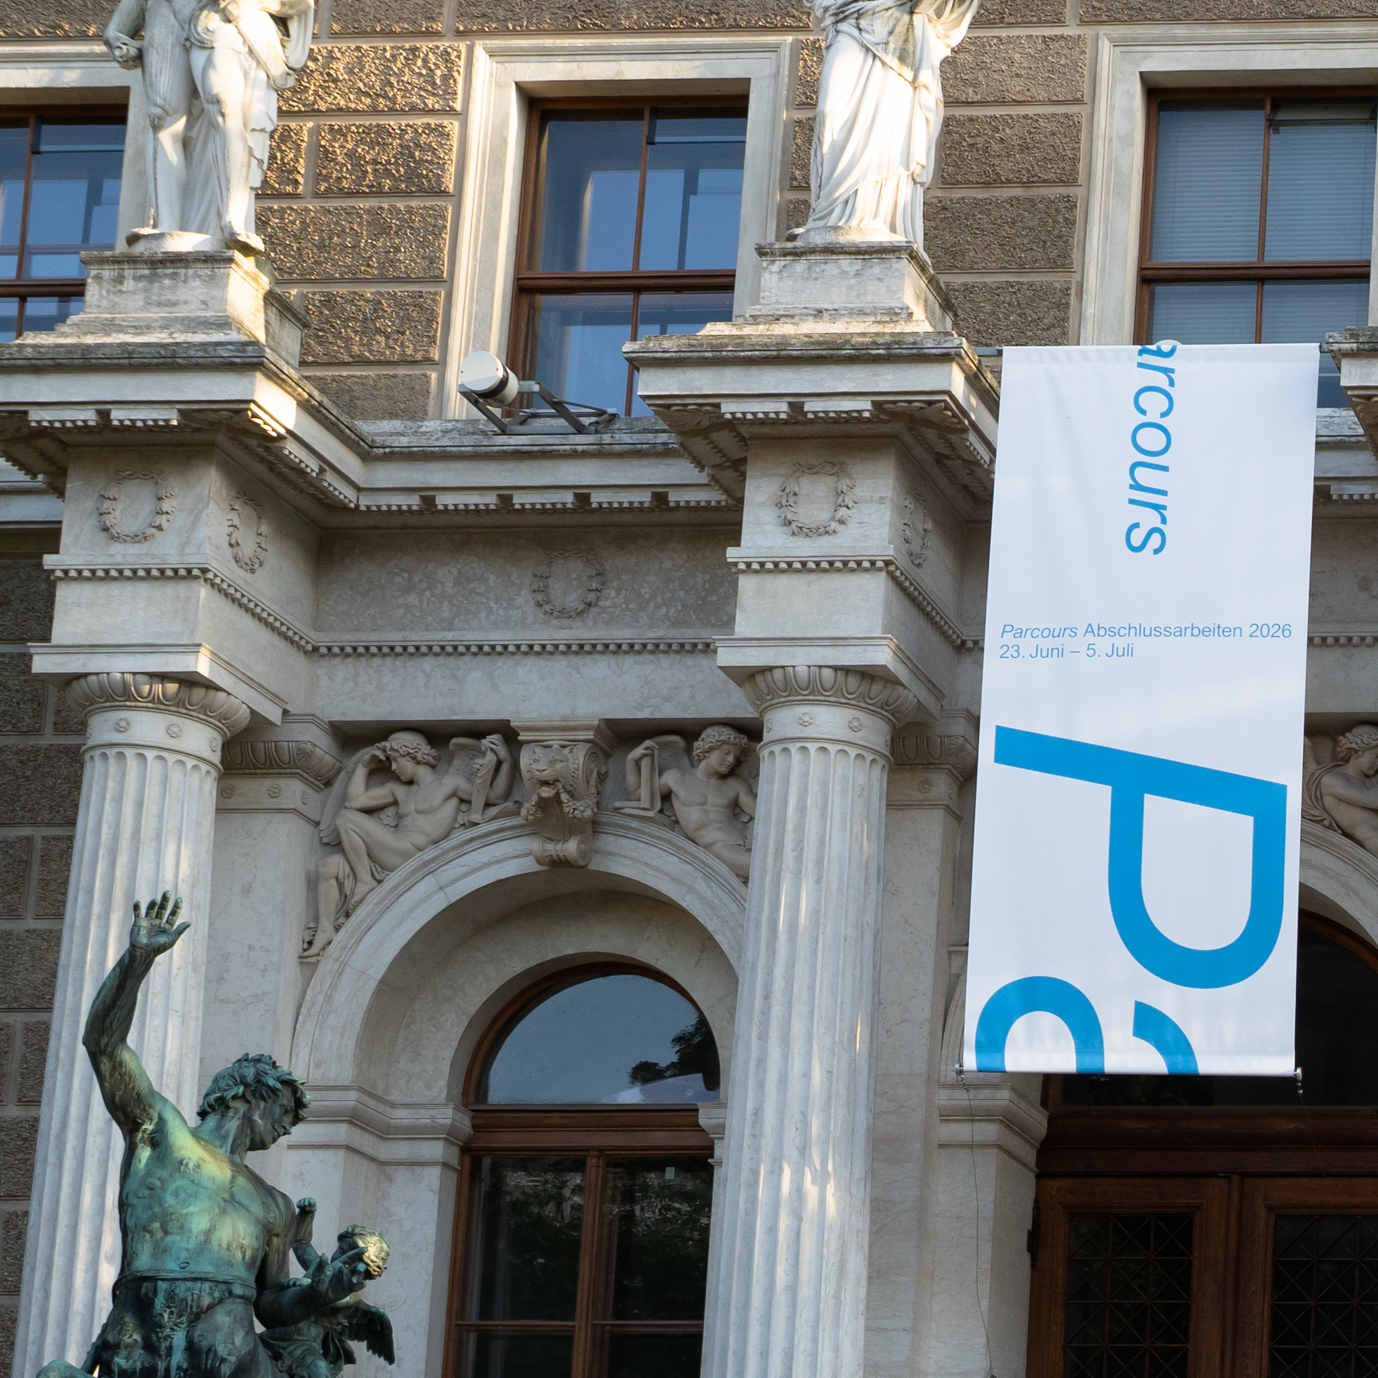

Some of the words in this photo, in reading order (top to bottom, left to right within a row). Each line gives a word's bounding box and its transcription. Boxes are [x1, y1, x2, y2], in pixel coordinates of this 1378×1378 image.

[1000, 623, 1078, 639] Parcours
[1083, 622, 1242, 638] Abschlussarbeiten
[1249, 623, 1292, 638] 2026
[999, 644, 1026, 659] 23.
[1029, 643, 1065, 658] Juni
[1086, 643, 1100, 658] 5.
[1105, 642, 1134, 658] Juli
